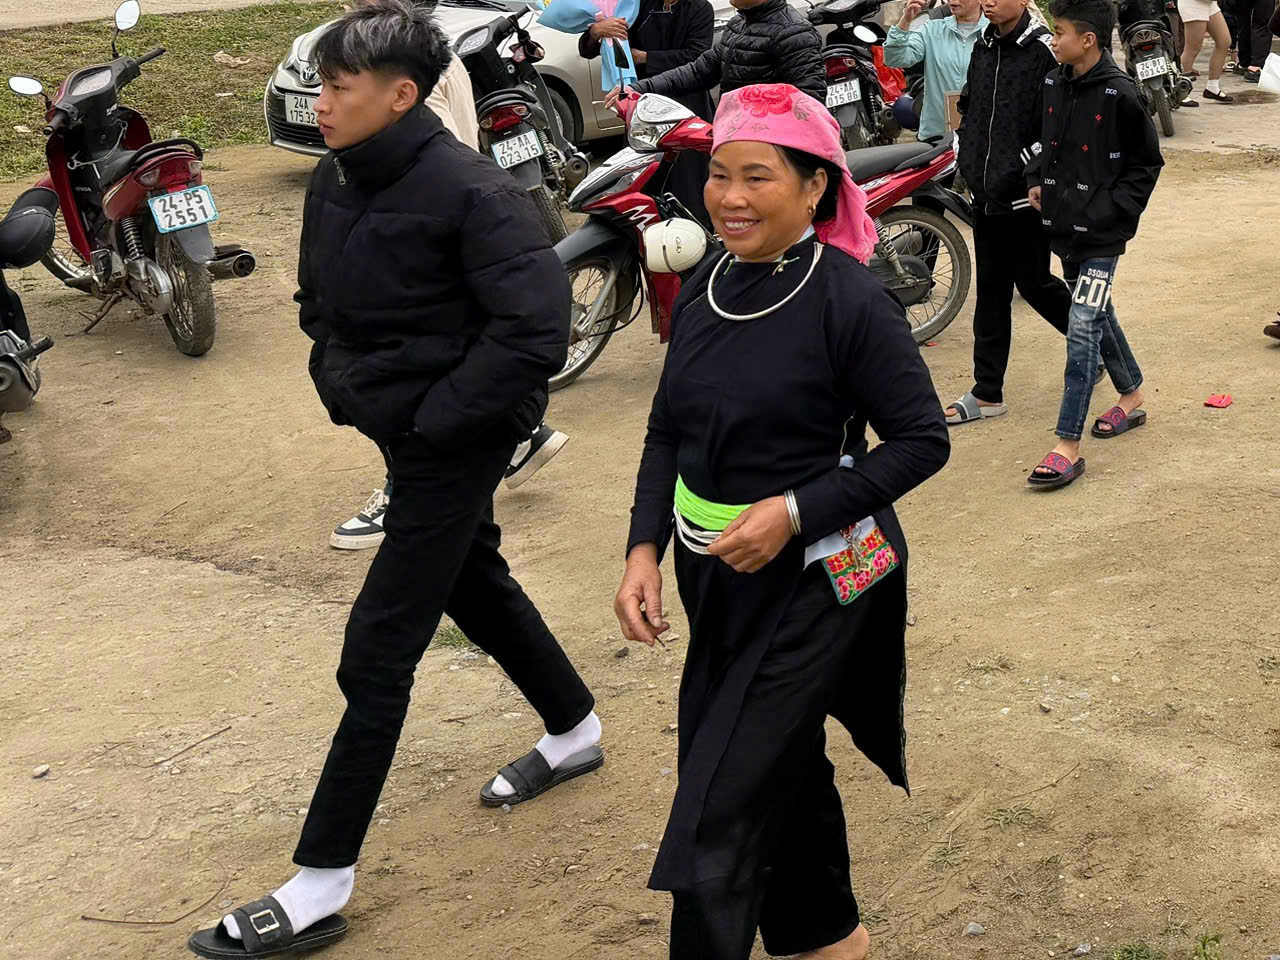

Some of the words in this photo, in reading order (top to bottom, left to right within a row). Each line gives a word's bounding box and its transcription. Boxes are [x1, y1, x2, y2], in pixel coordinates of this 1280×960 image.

[827, 90, 858, 107] 015.86
[829, 81, 854, 97] 24-AA
[499, 134, 531, 155] 24-AA
[500, 143, 539, 168] 023.15
[164, 204, 209, 228] 2551
